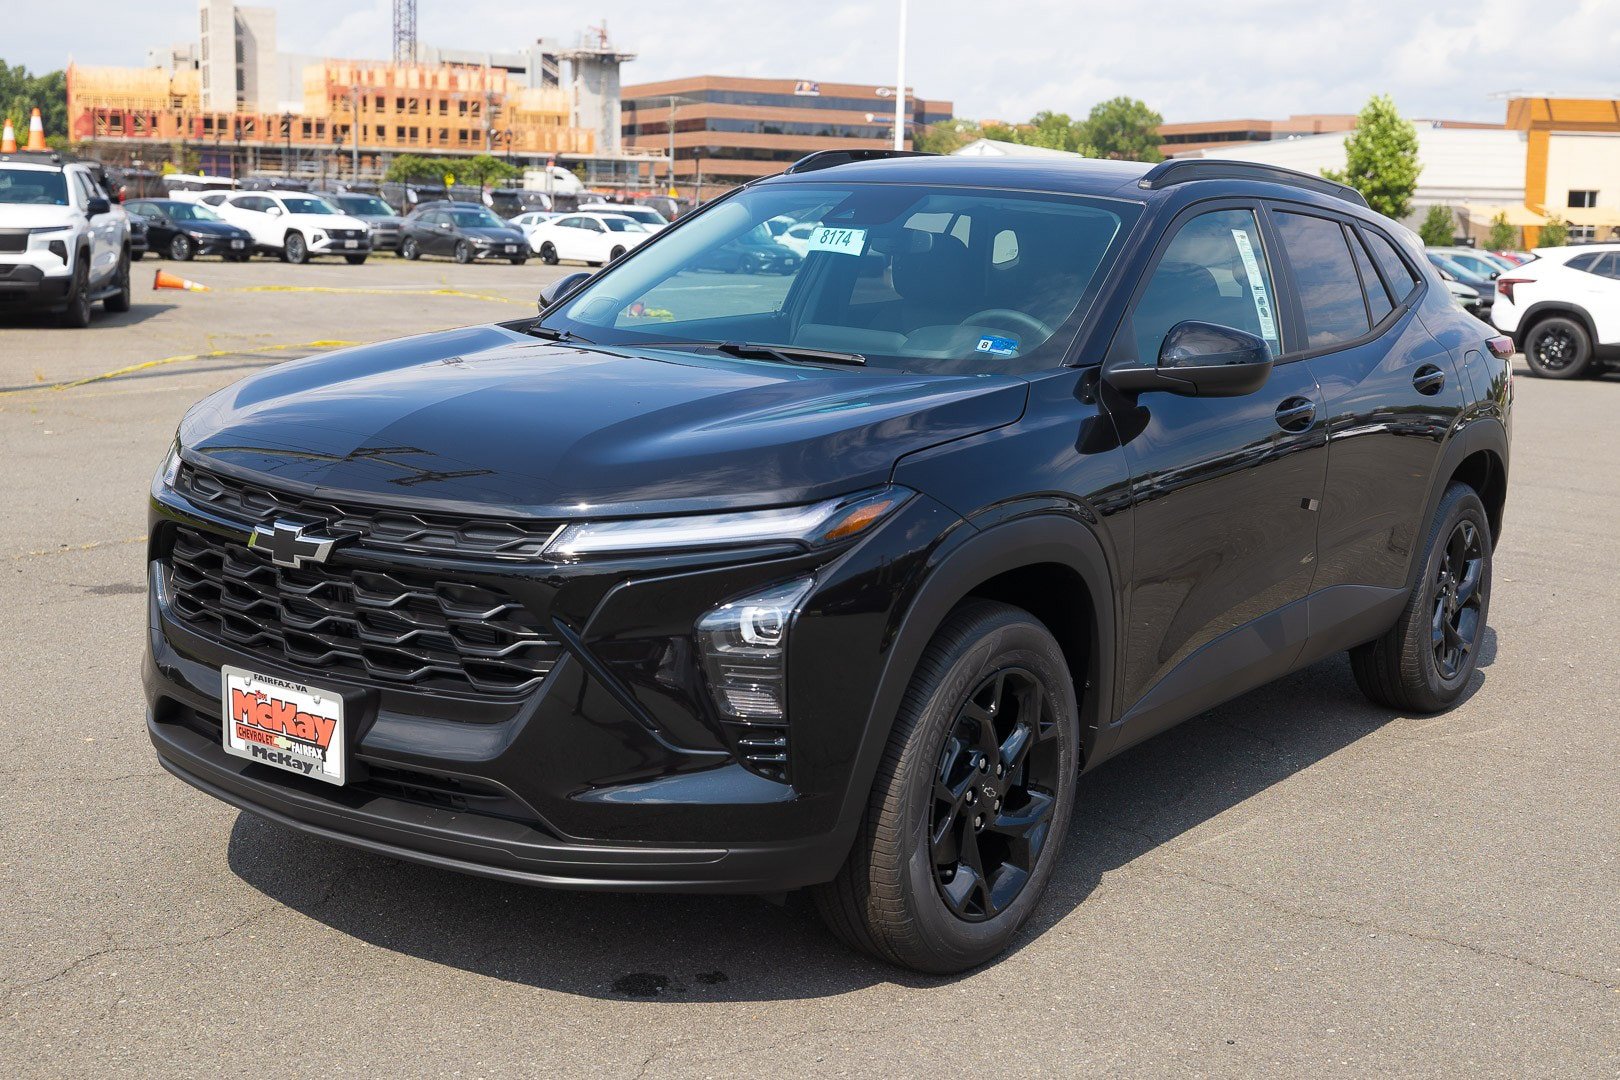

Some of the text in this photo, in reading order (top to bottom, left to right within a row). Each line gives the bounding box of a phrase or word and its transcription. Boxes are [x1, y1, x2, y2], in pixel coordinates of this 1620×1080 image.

[820, 229, 852, 247] 8174
[981, 341, 989, 349] 8
[295, 684, 308, 693] VA
[232, 687, 337, 752] McKay
[238, 727, 273, 745] CHEVROLET
[252, 745, 313, 774] McKay
[291, 742, 323, 759] FAIRFAX
